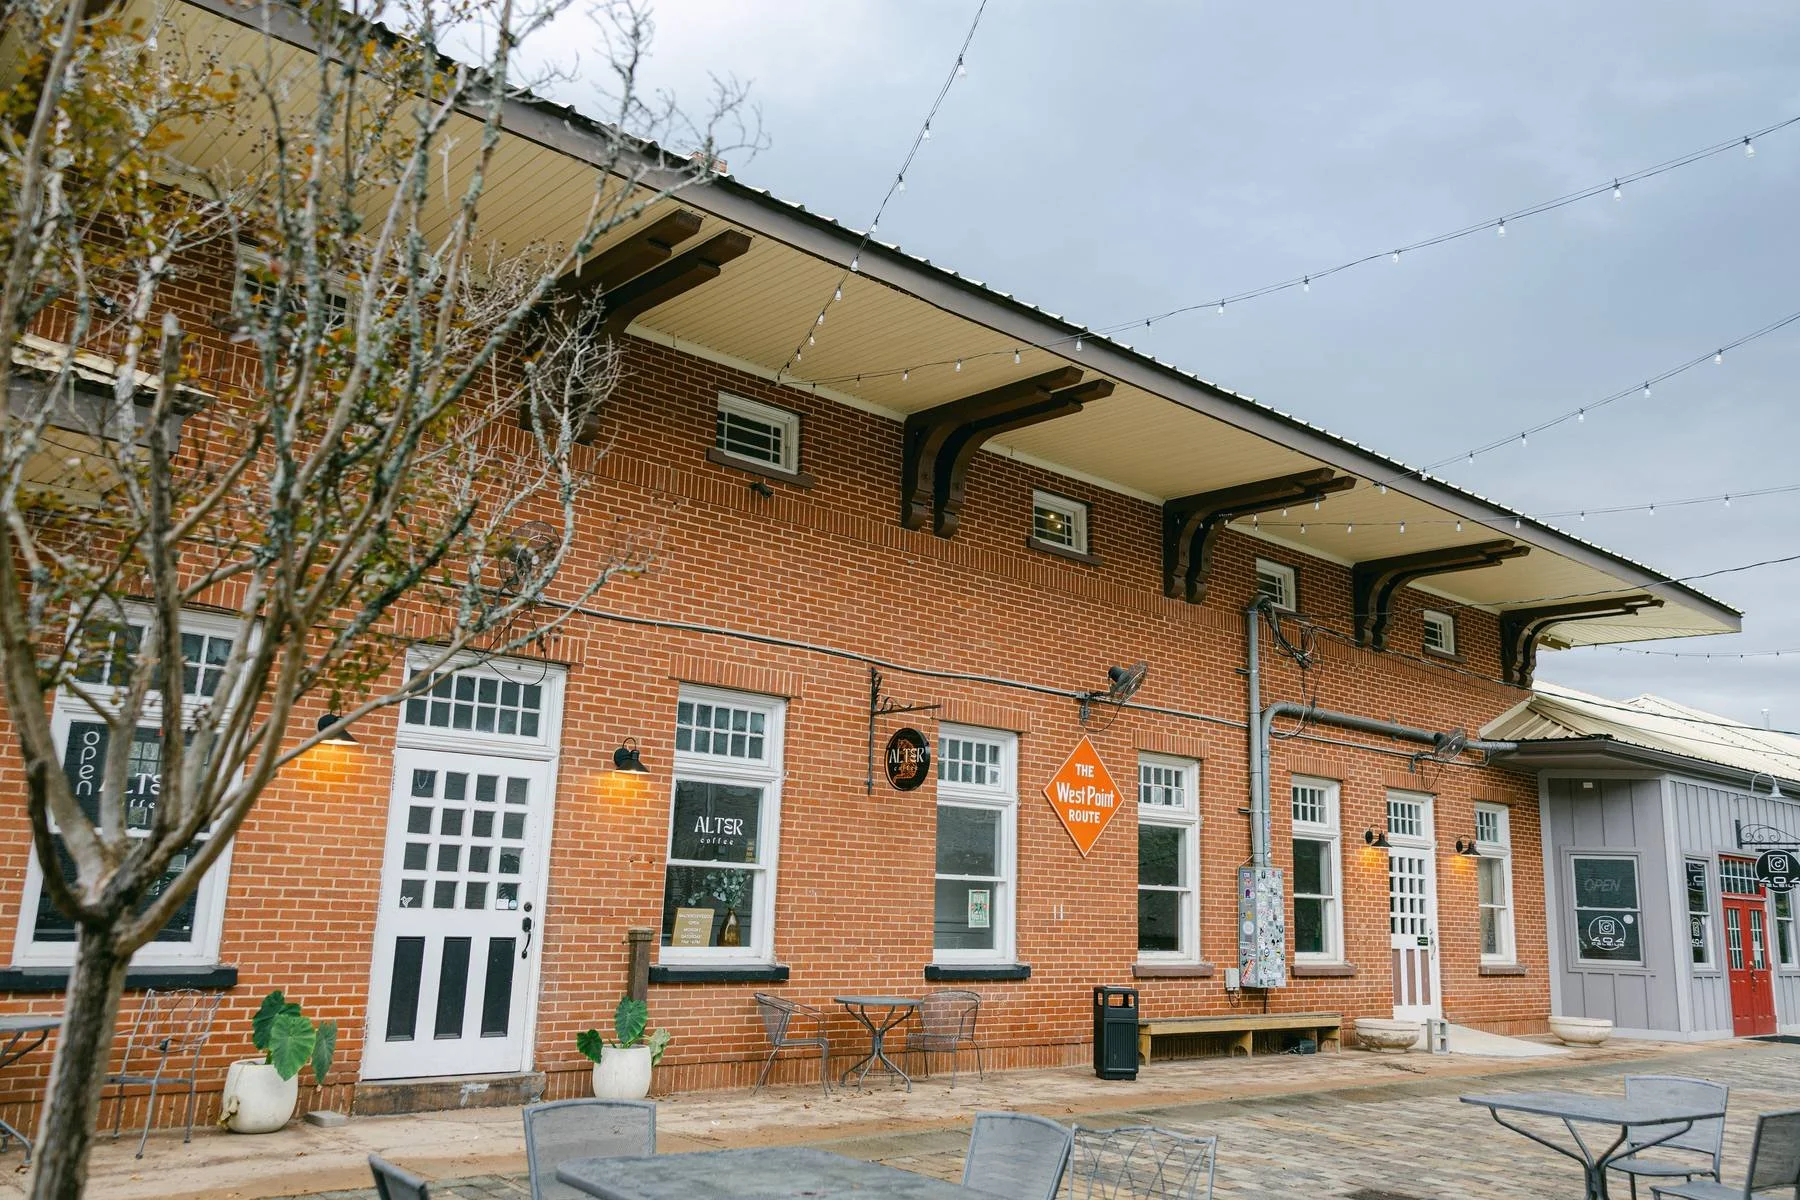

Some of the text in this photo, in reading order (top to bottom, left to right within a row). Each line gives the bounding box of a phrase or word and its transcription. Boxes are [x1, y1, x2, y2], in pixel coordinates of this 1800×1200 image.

[76, 731, 100, 796] open
[889, 747, 924, 764] ALTER
[1075, 763, 1095, 778] THE
[1056, 781, 1115, 808] West Point
[1068, 810, 1101, 824] ROUTE
[694, 815, 744, 836] ALTER
[700, 837, 734, 846] coffee
[1584, 878, 1621, 892] OPEN
